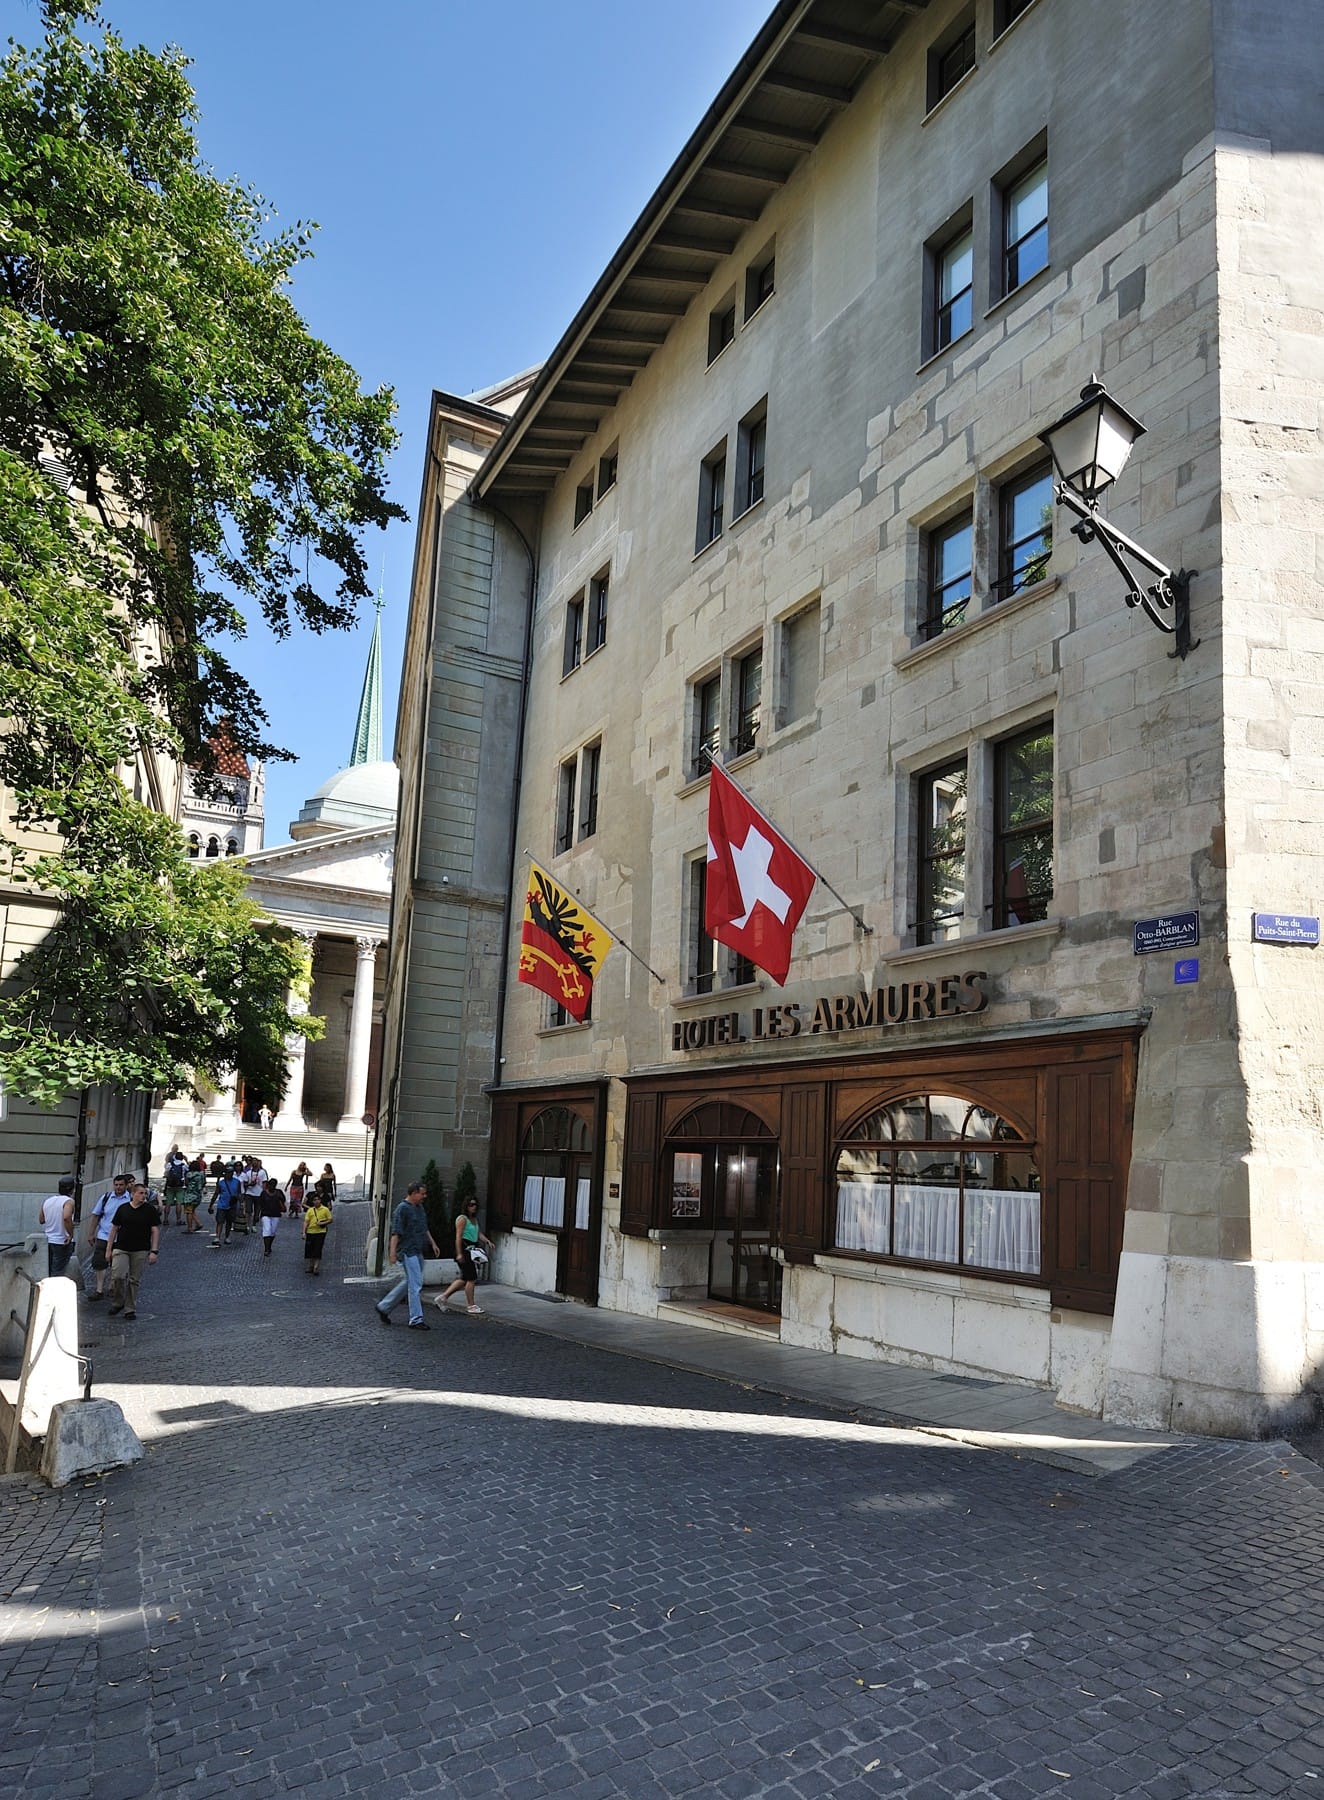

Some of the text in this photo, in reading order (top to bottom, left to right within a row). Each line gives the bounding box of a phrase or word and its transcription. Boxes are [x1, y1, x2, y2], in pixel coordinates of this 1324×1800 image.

[1158, 919, 1173, 928] Rue
[1274, 917, 1301, 928] Rue du
[1137, 922, 1195, 940] Otto-BARBLAN
[1258, 925, 1318, 938] Puits-Saint-Pierre
[671, 970, 988, 1051] HOTEL LES ARMURES
